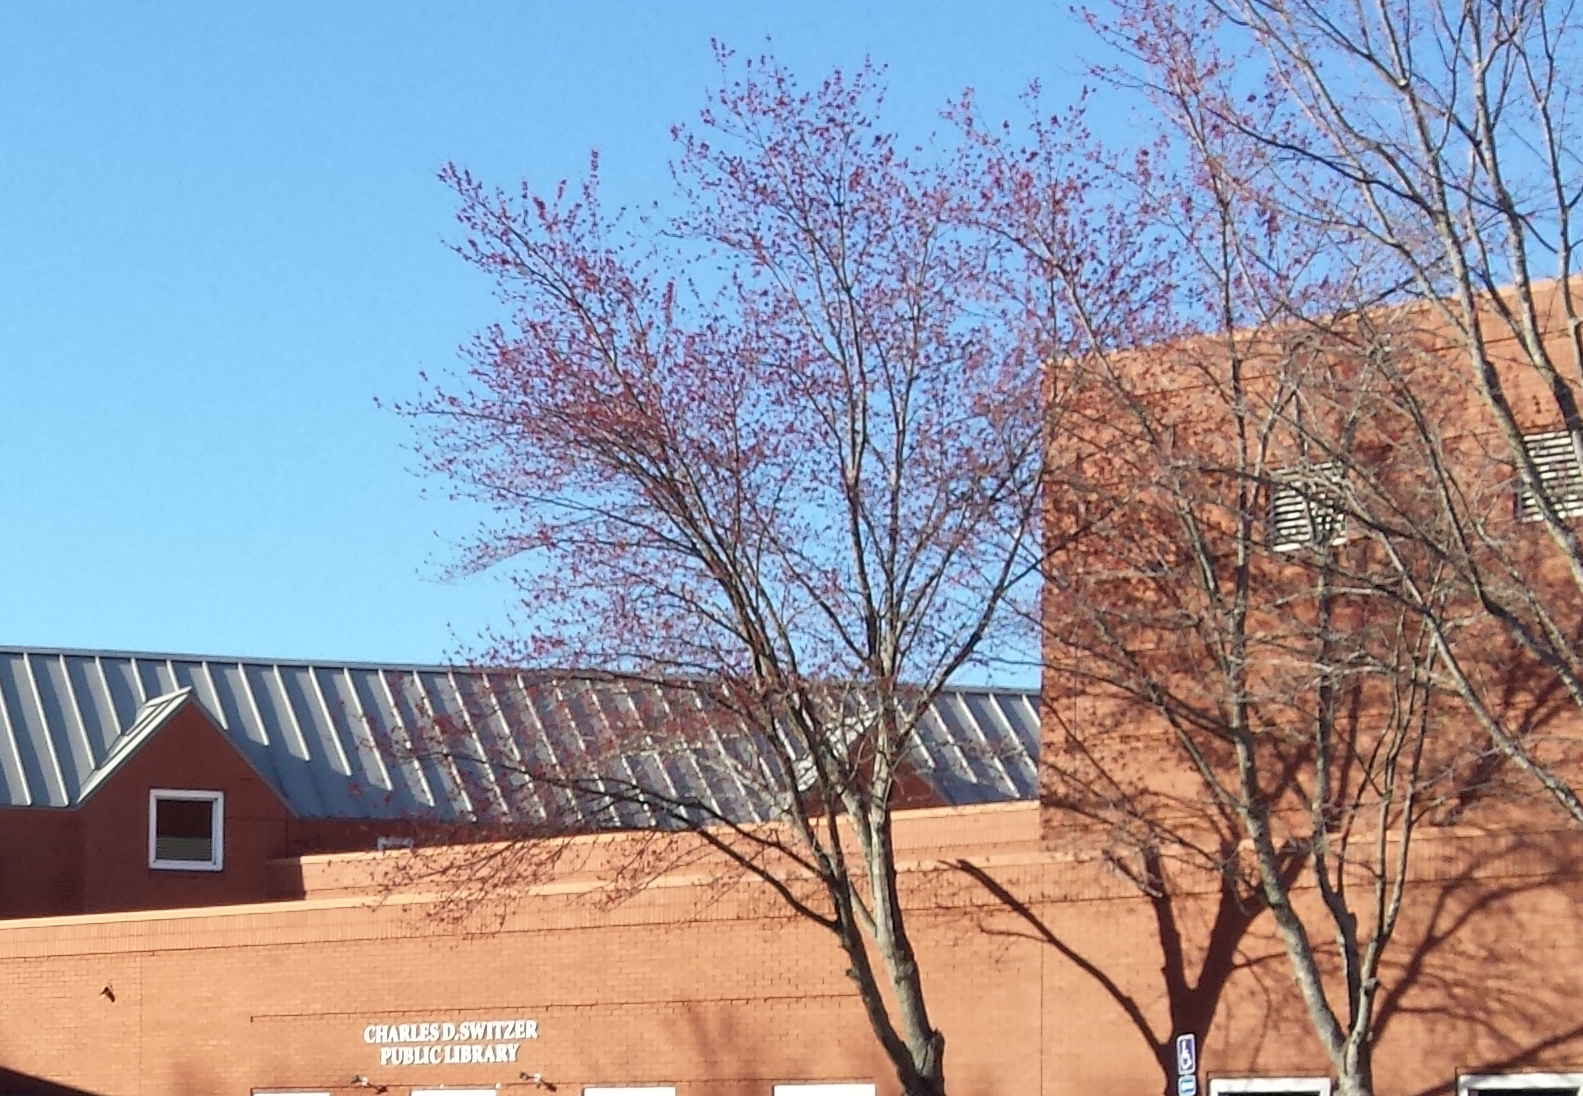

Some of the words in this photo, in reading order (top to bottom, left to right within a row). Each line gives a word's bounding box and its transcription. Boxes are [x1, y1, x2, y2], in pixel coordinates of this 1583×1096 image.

[363, 1022, 440, 1044] CHARLES
[380, 1047, 442, 1066] PUBLIC
[444, 1043, 520, 1064] LIBRARY
